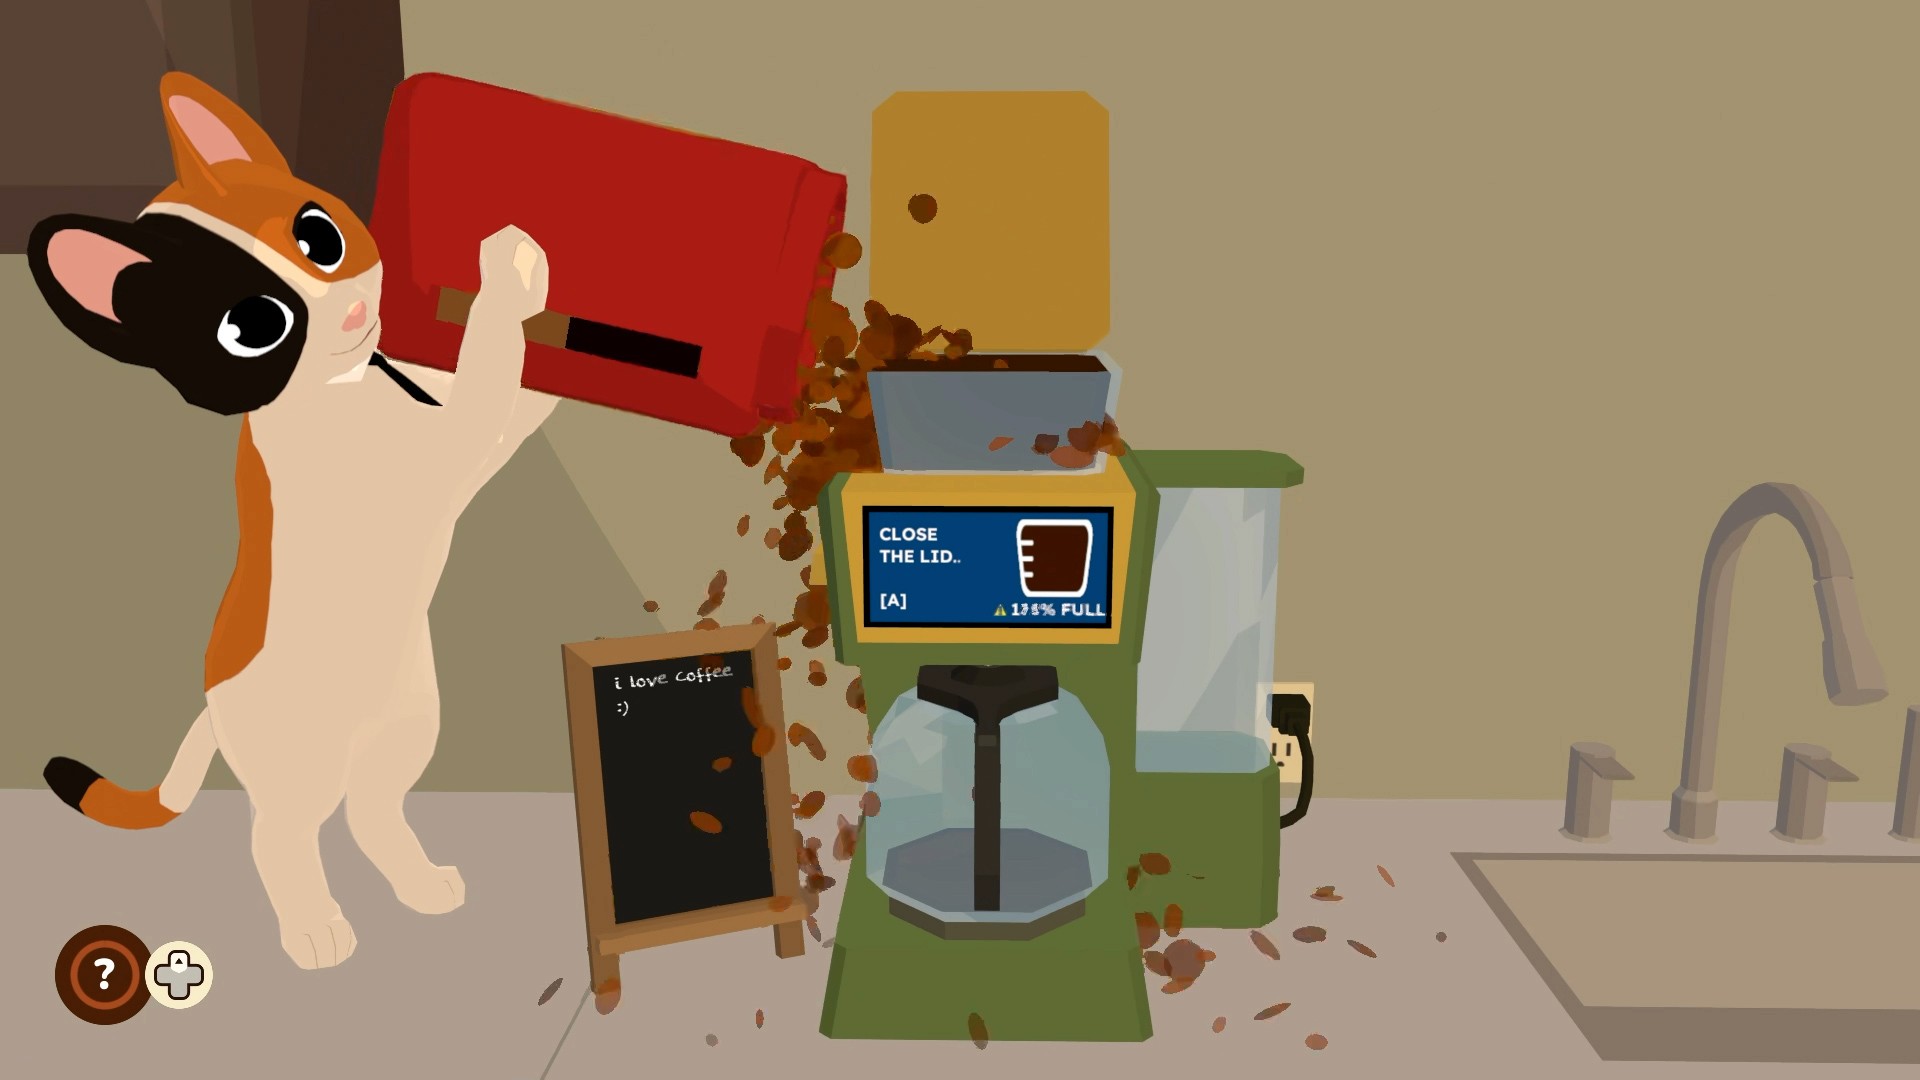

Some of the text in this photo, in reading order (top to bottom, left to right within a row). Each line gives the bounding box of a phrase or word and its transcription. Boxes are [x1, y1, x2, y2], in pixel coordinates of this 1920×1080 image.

[879, 527, 938, 542] CLOSE
[879, 549, 962, 564] THE LID..
[880, 593, 907, 610] [A]
[1061, 602, 1106, 617] FULL
[614, 665, 733, 690] i love coffee
